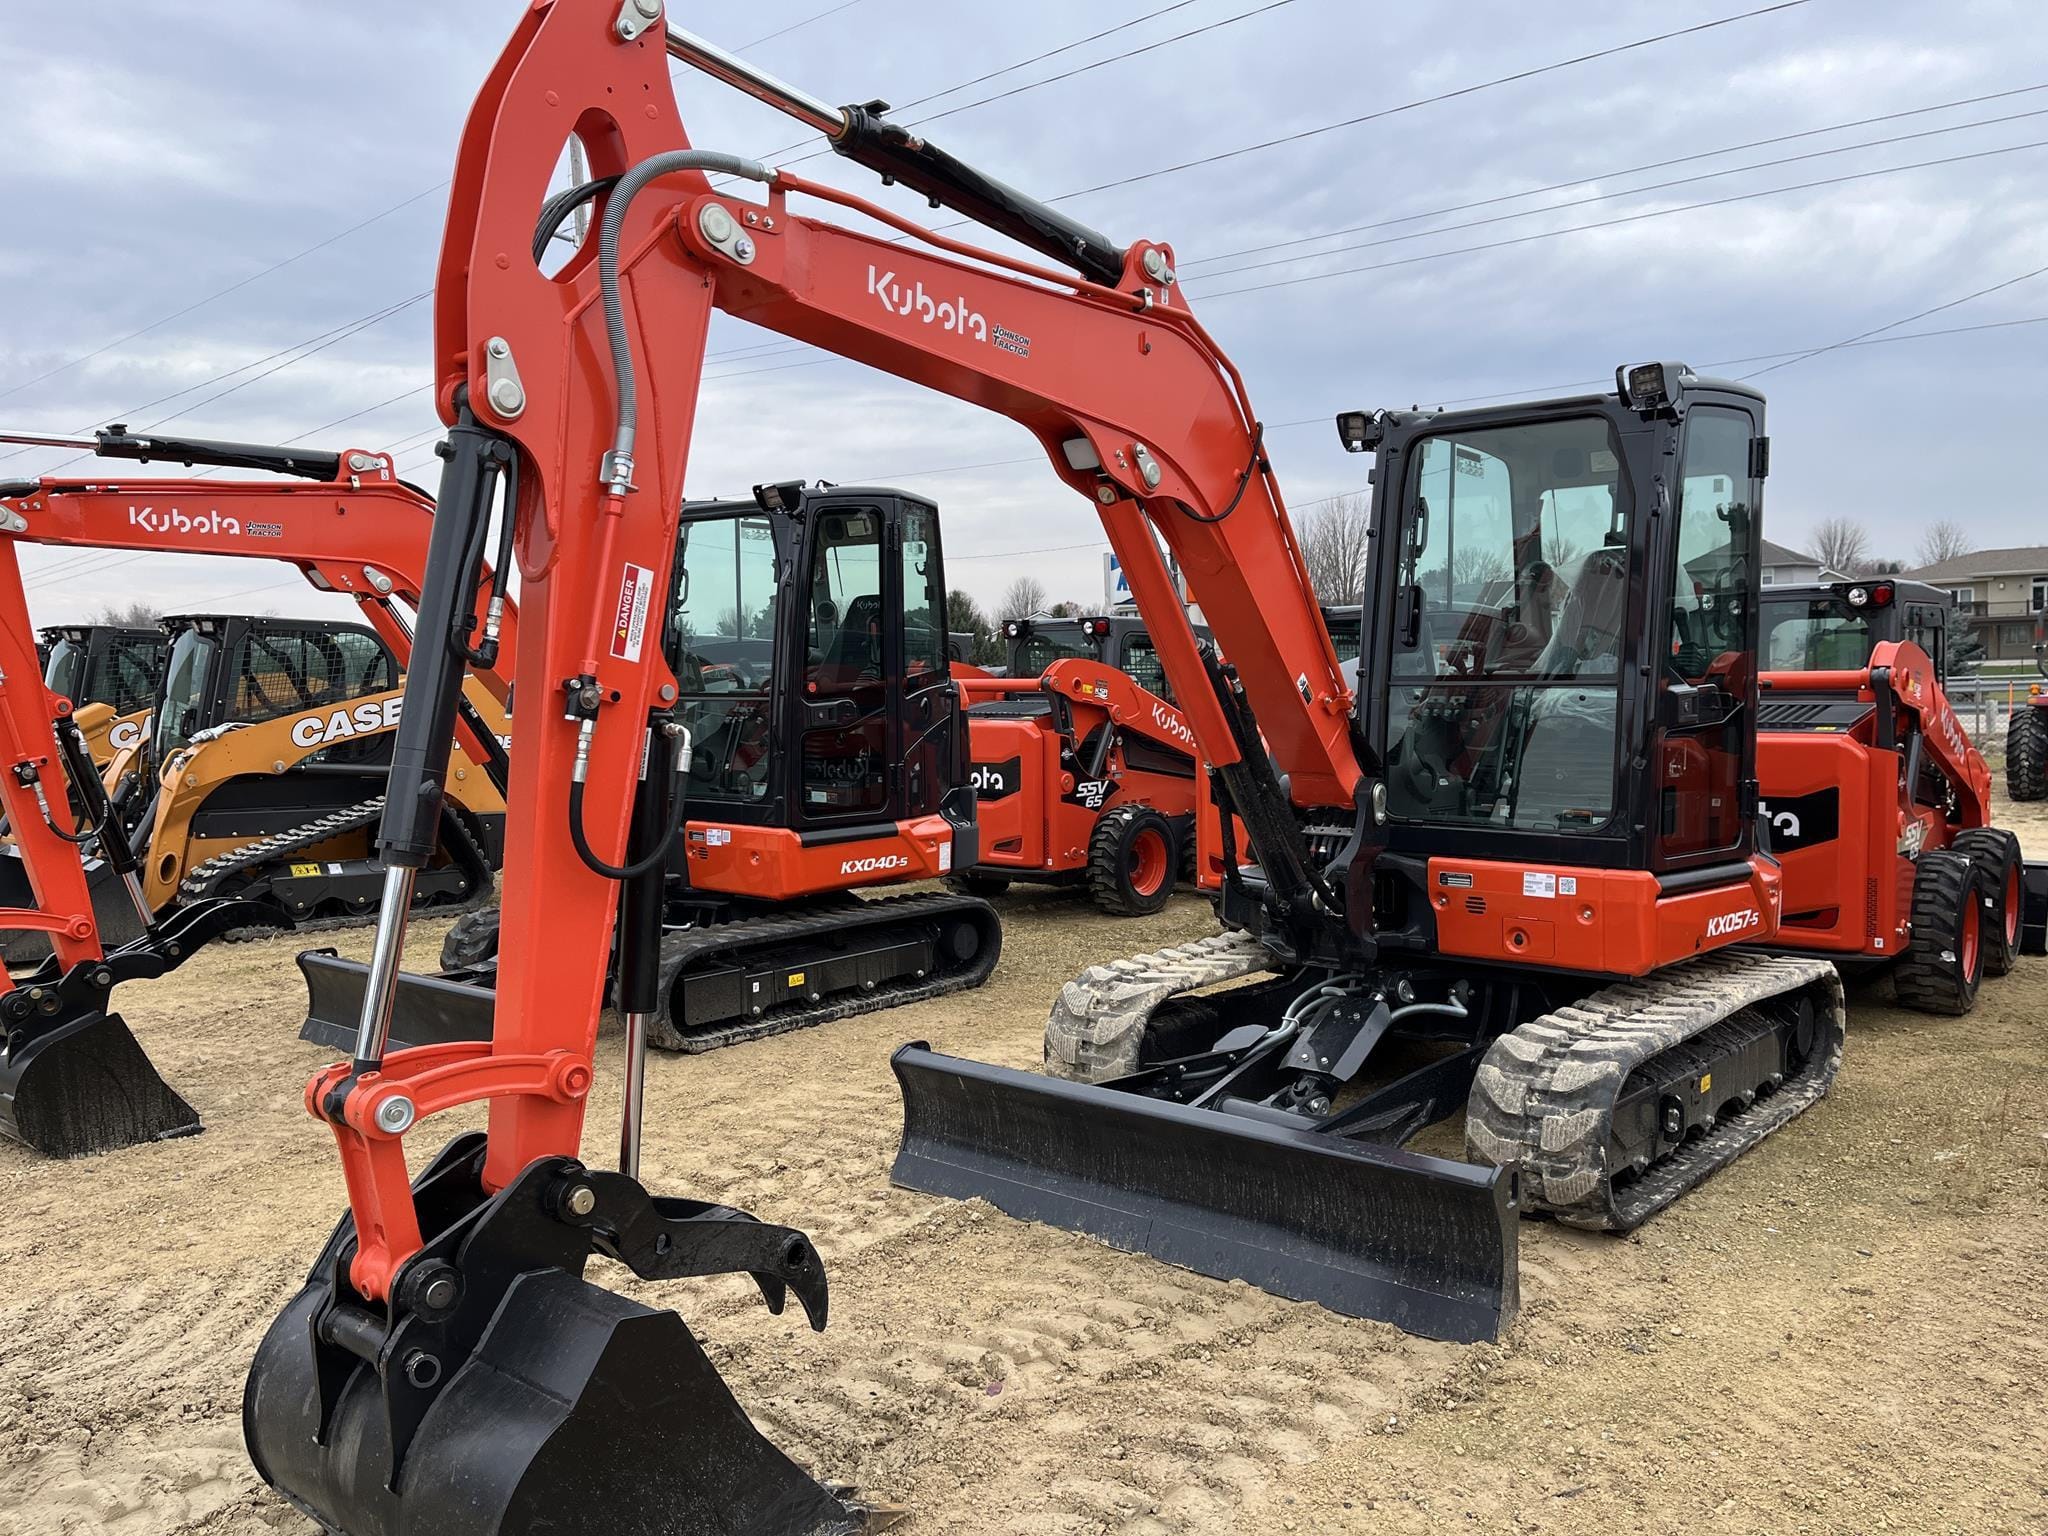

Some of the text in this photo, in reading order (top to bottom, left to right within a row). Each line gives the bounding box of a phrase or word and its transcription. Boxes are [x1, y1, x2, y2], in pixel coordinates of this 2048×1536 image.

[868, 264, 987, 342] Kubota
[993, 324, 1030, 346] JOHNSON
[993, 335, 1029, 357] TRACTOR
[128, 506, 240, 535] Kubota
[246, 521, 282, 530] JOHNSON
[247, 529, 281, 537] TRACTOR
[619, 579, 635, 628] DANGER
[856, 600, 880, 610] Kubo
[291, 696, 403, 748] CASE
[1152, 702, 1197, 748] Kubot
[970, 766, 1003, 790] ota
[1076, 780, 1109, 797] SSV
[1085, 795, 1103, 808] 65
